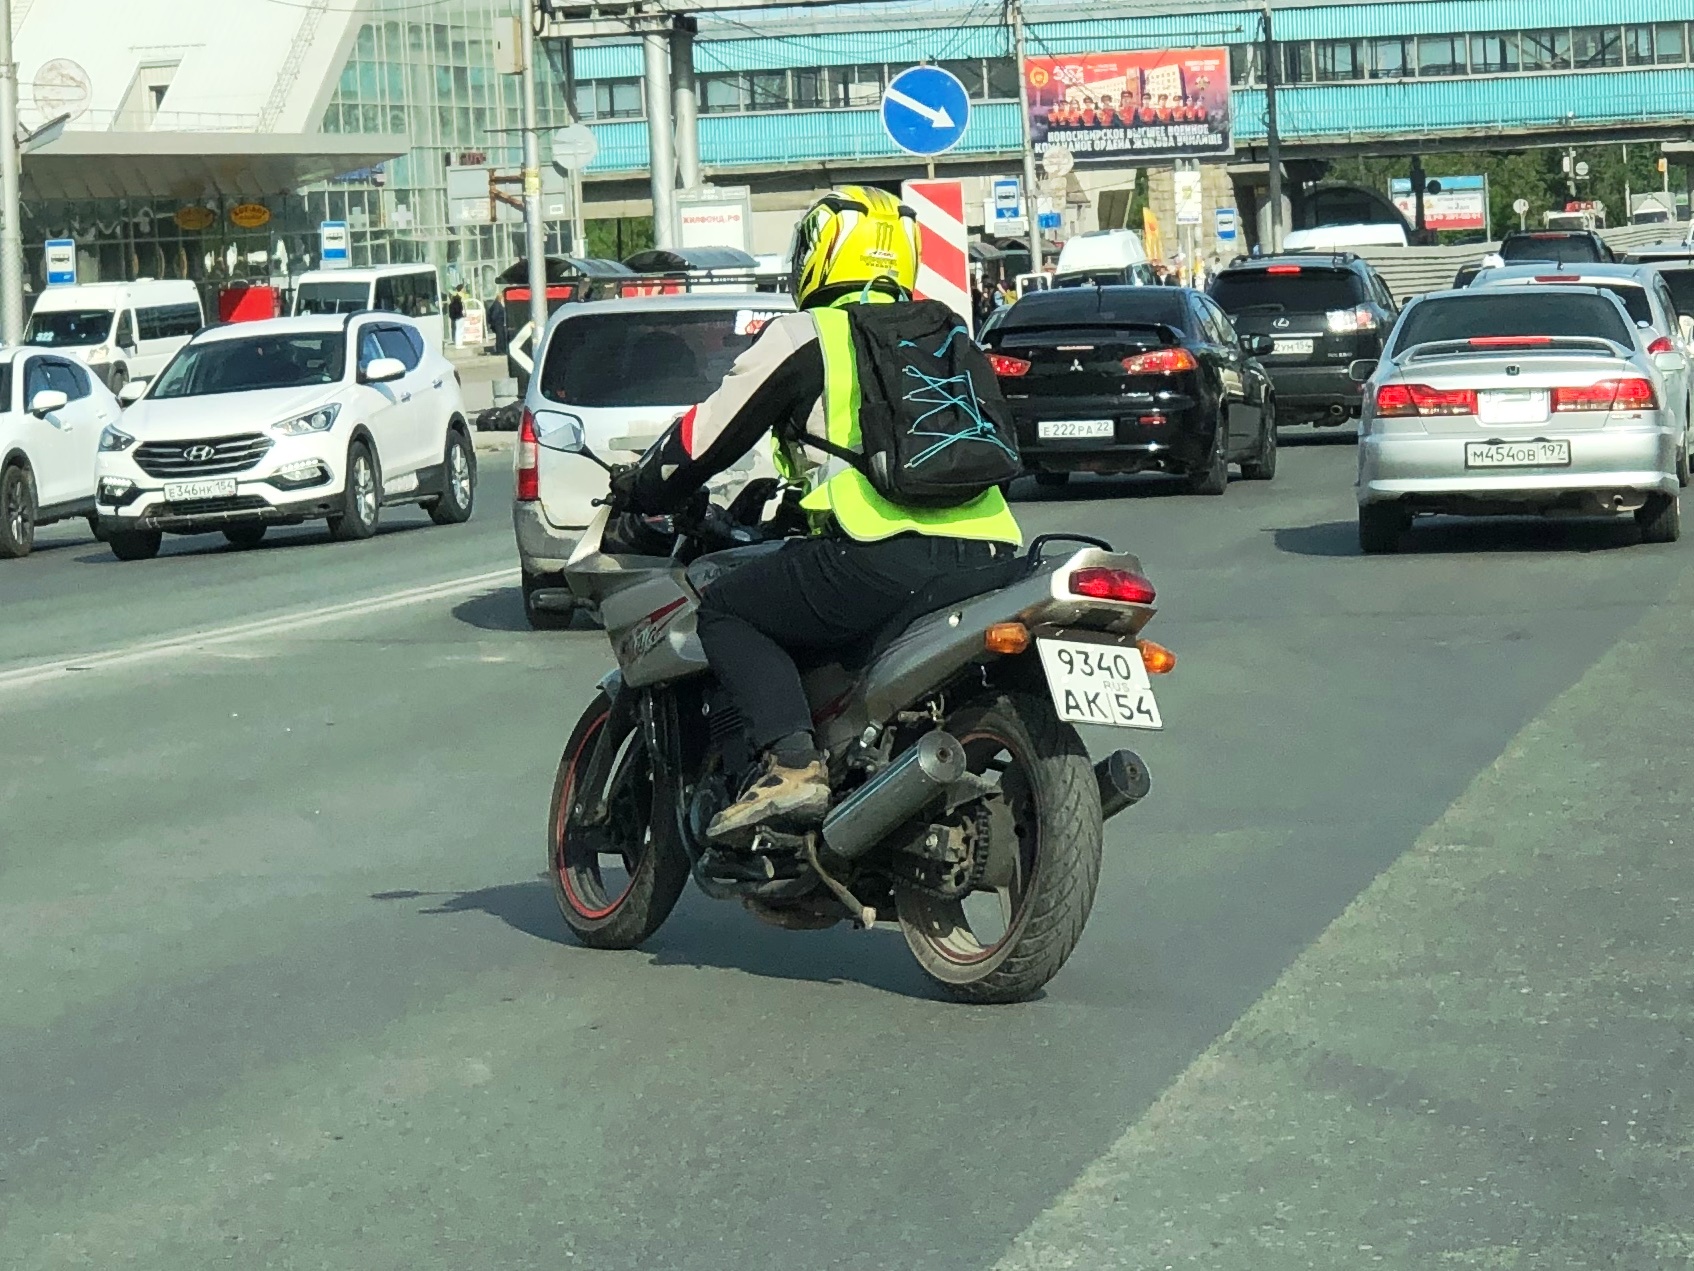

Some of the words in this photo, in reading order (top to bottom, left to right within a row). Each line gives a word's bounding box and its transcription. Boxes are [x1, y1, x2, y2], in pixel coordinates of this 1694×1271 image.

[1048, 128, 1124, 143] НОВОСИБИРСКОЕ
[1127, 126, 1165, 138] ВЫСШЕЕ
[1168, 124, 1209, 136] ВОЕННОЕ
[1094, 138, 1131, 151] ОРДЕНА
[1133, 135, 1175, 148] ЖУКОВА
[1177, 134, 1223, 146] УЧИЛИЩЕ
[1540, 443, 1564, 457] 197
[216, 480, 233, 491] 154
[1057, 648, 1131, 681] 9340
[1103, 680, 1130, 692] RUS
[1115, 693, 1154, 722] 54
